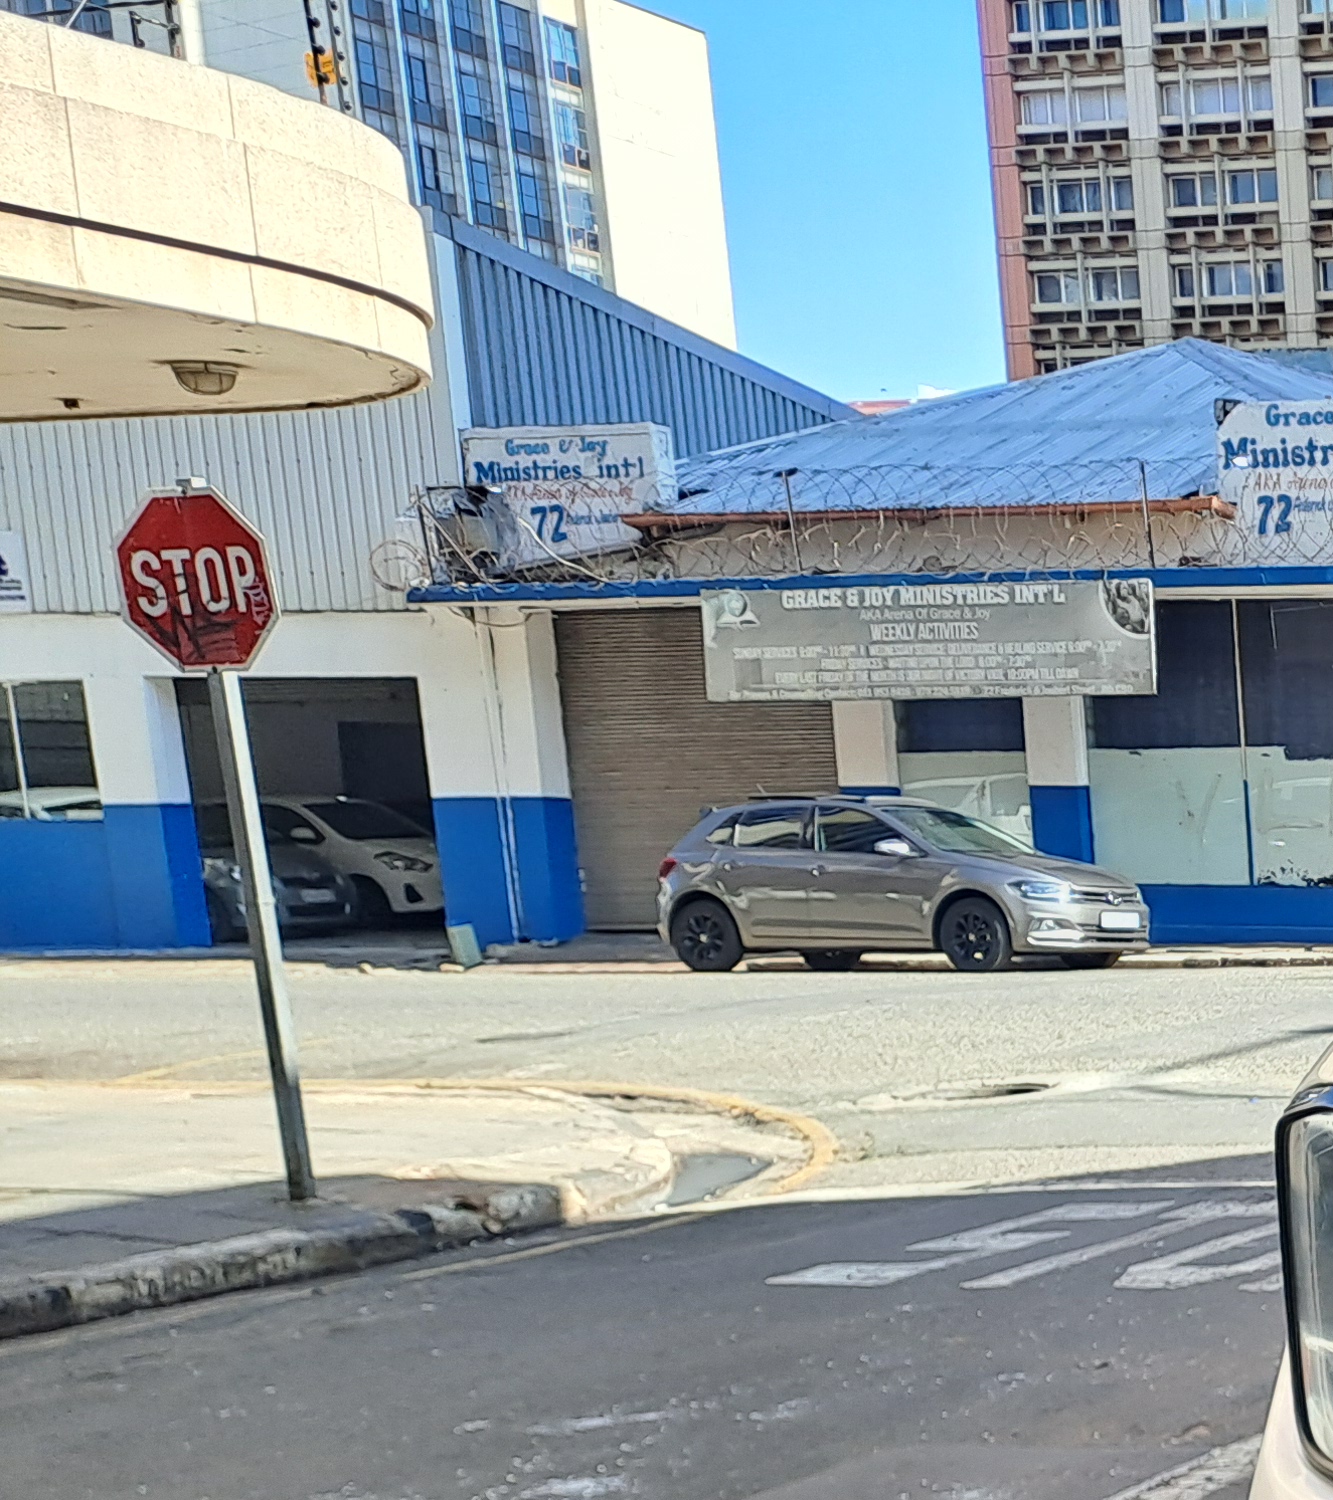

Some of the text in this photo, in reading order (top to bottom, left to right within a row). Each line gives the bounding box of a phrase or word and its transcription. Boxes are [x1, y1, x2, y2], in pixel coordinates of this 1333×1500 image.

[473, 458, 582, 484] Ministries
[530, 503, 568, 544] 72
[1257, 493, 1292, 535] 72
[130, 545, 257, 618] STOP
[781, 584, 1066, 609] GRACE & JOY MINISTRIES INT'L
[859, 608, 882, 621] AKA
[882, 608, 913, 621] Arena
[932, 607, 960, 621] Grace
[973, 607, 991, 622] Joy
[869, 621, 979, 642] WEEKLY ACTIVITIES
